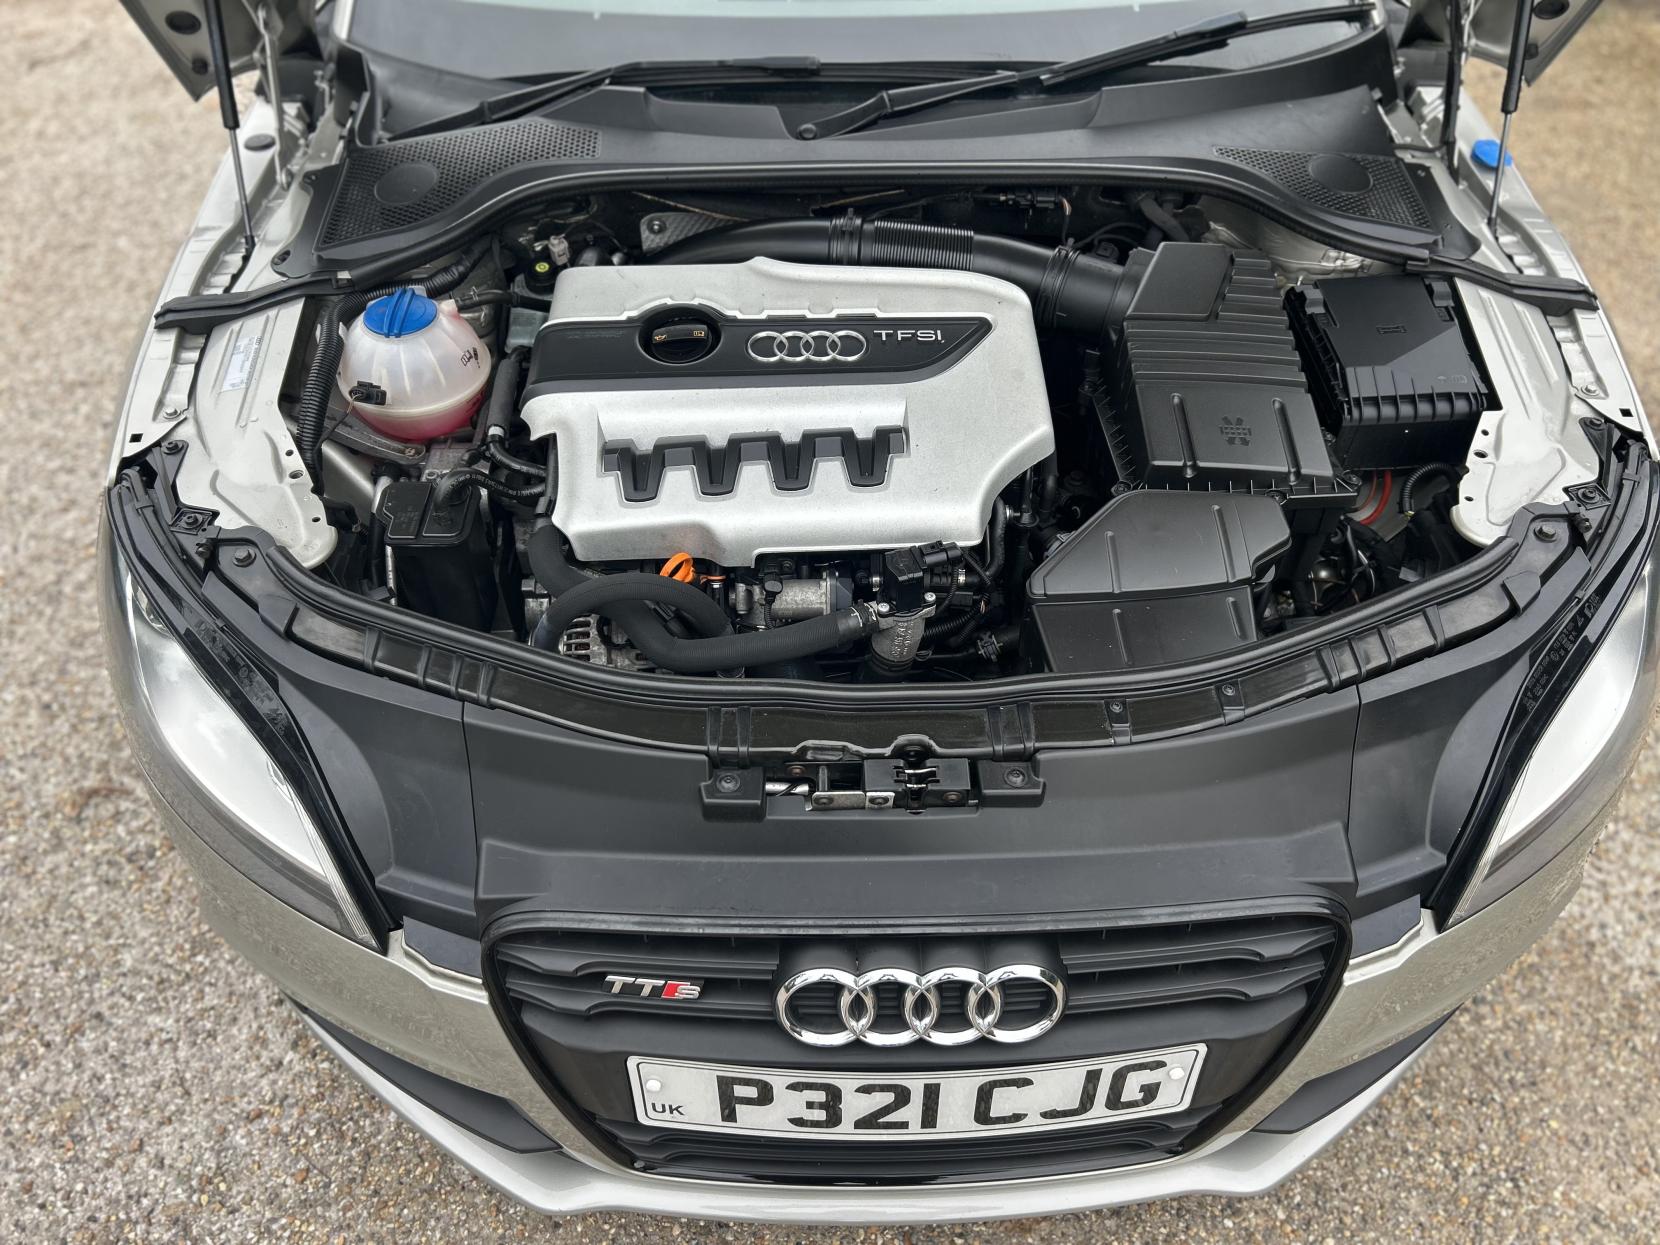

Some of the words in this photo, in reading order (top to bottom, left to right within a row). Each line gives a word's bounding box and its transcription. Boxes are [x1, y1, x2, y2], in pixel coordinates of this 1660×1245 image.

[873, 329, 942, 341] TFSI
[604, 975, 701, 1000] TTS
[716, 1074, 941, 1130] P321
[974, 1060, 1167, 1126] CJG
[651, 1102, 685, 1116] UK
